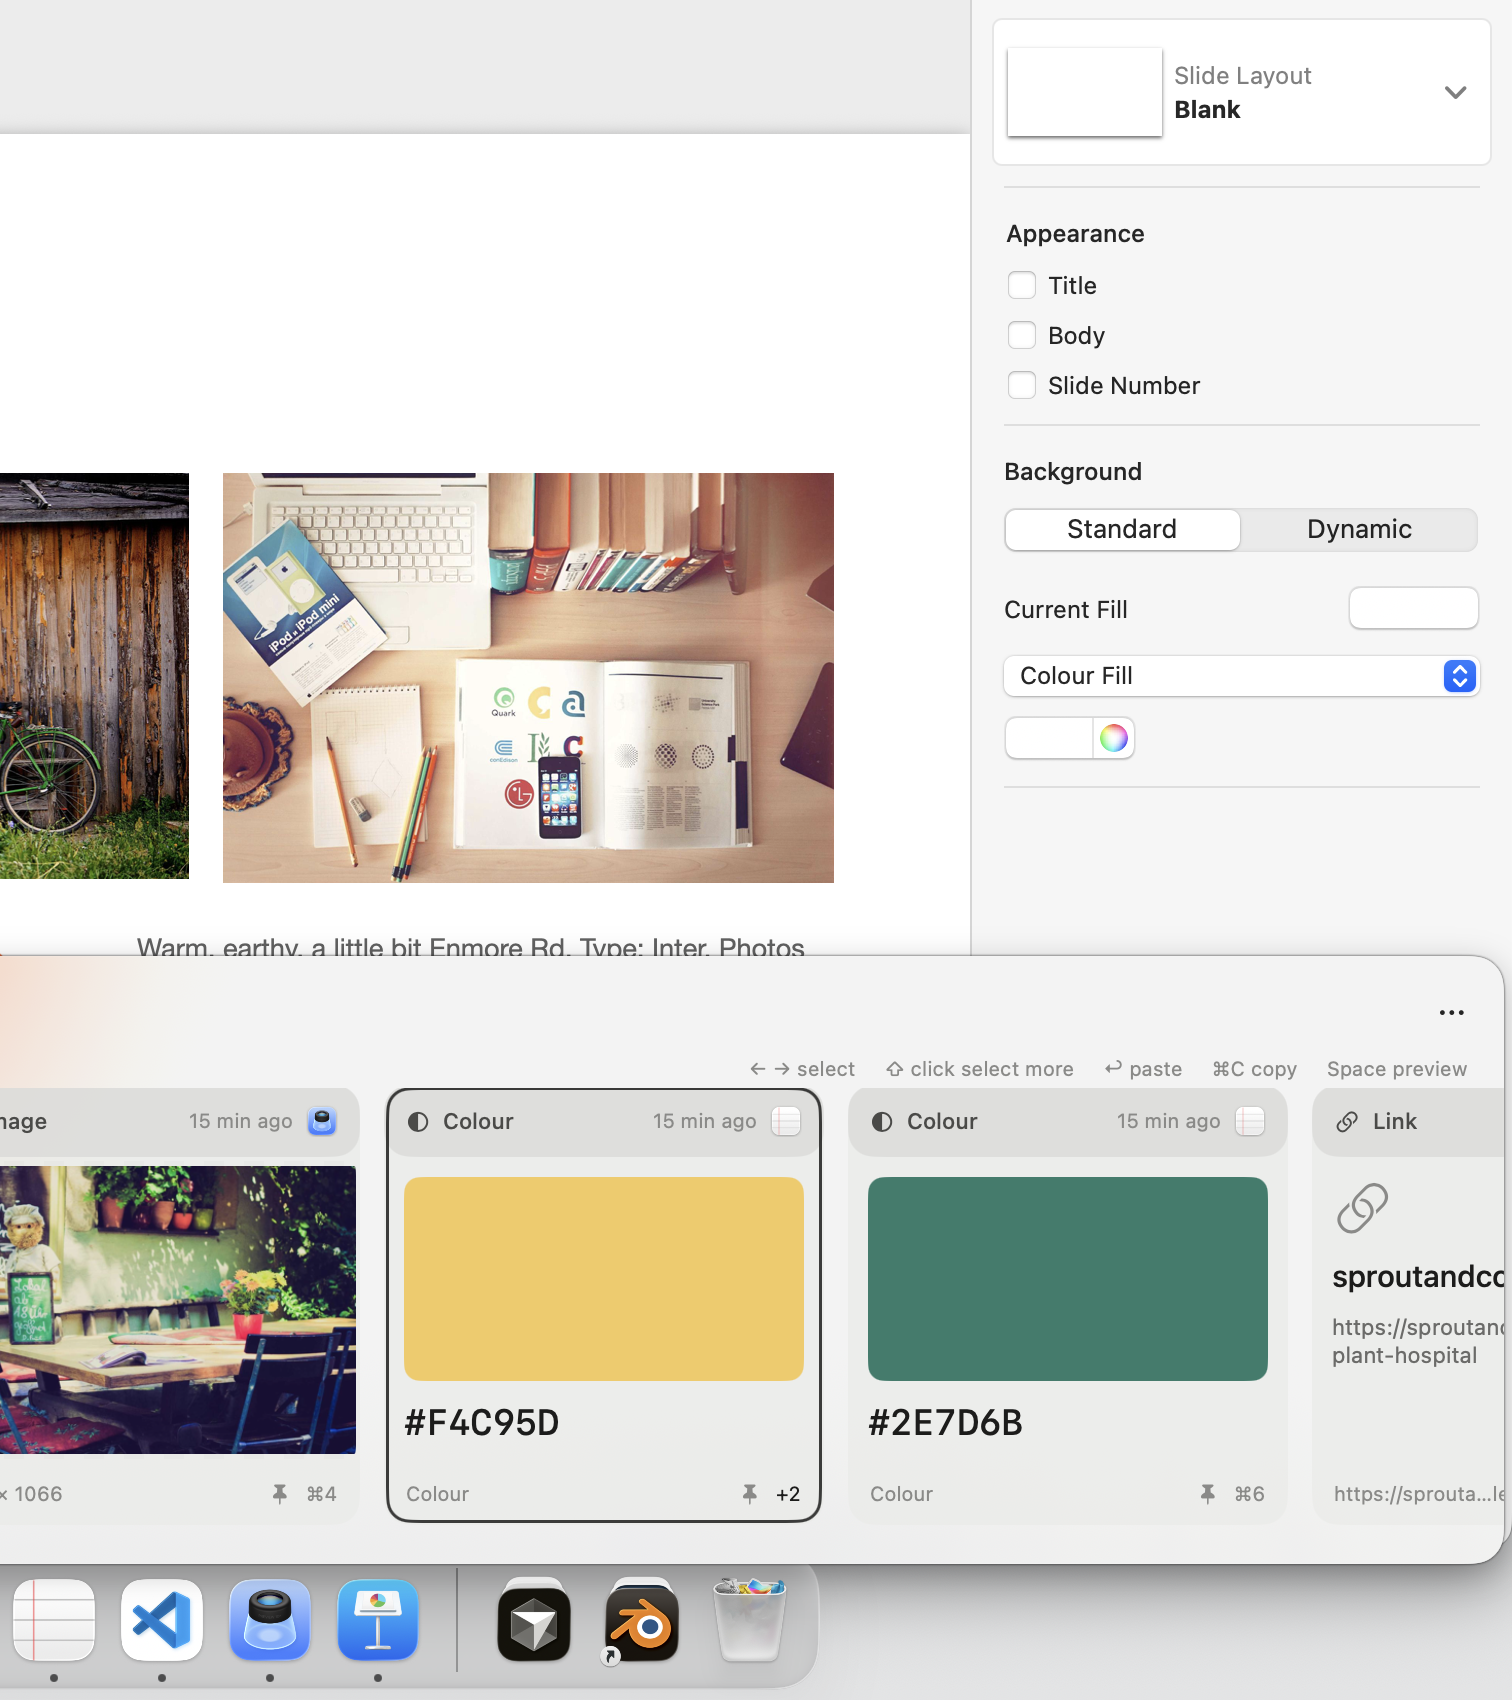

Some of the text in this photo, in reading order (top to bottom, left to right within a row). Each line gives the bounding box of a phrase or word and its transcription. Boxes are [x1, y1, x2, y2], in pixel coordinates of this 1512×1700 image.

[1174, 65, 1312, 90] Slide Layout
[1175, 99, 1242, 119] Blank
[1006, 223, 1145, 247] Appearance
[1048, 275, 1097, 295] Title
[1049, 325, 1106, 350] Body
[1048, 375, 1201, 396] Slide Number
[1005, 461, 1142, 486] Background
[1067, 517, 1177, 540] Standard
[1308, 517, 1412, 544] Dynamic
[1004, 599, 1127, 620] Current Fill
[268, 630, 293, 653] iPod
[295, 610, 321, 632] iPod
[318, 593, 340, 613] mini
[1020, 665, 1132, 686] Colour Fill
[491, 709, 516, 717] Quark
[311, 942, 326, 956] a
[334, 937, 384, 956] little
[391, 937, 422, 956] bit
[429, 937, 523, 956] Enmore
[719, 937, 806, 956] Photos
[797, 1060, 856, 1077] select
[910, 1060, 1074, 1077] click select more
[1130, 1061, 1183, 1081] paste
[1251, 1064, 1298, 1081] copy
[1327, 1060, 1468, 1081] Space preview
[443, 1111, 515, 1131] Colour
[907, 1111, 979, 1131] Colour
[1374, 1111, 1418, 1130] Link
[1332, 1345, 1477, 1368] plant-hospital
[404, 1408, 559, 1437] #F4C95D
[868, 1408, 1023, 1437] #2E7D6B
[776, 1485, 801, 1502] +2
